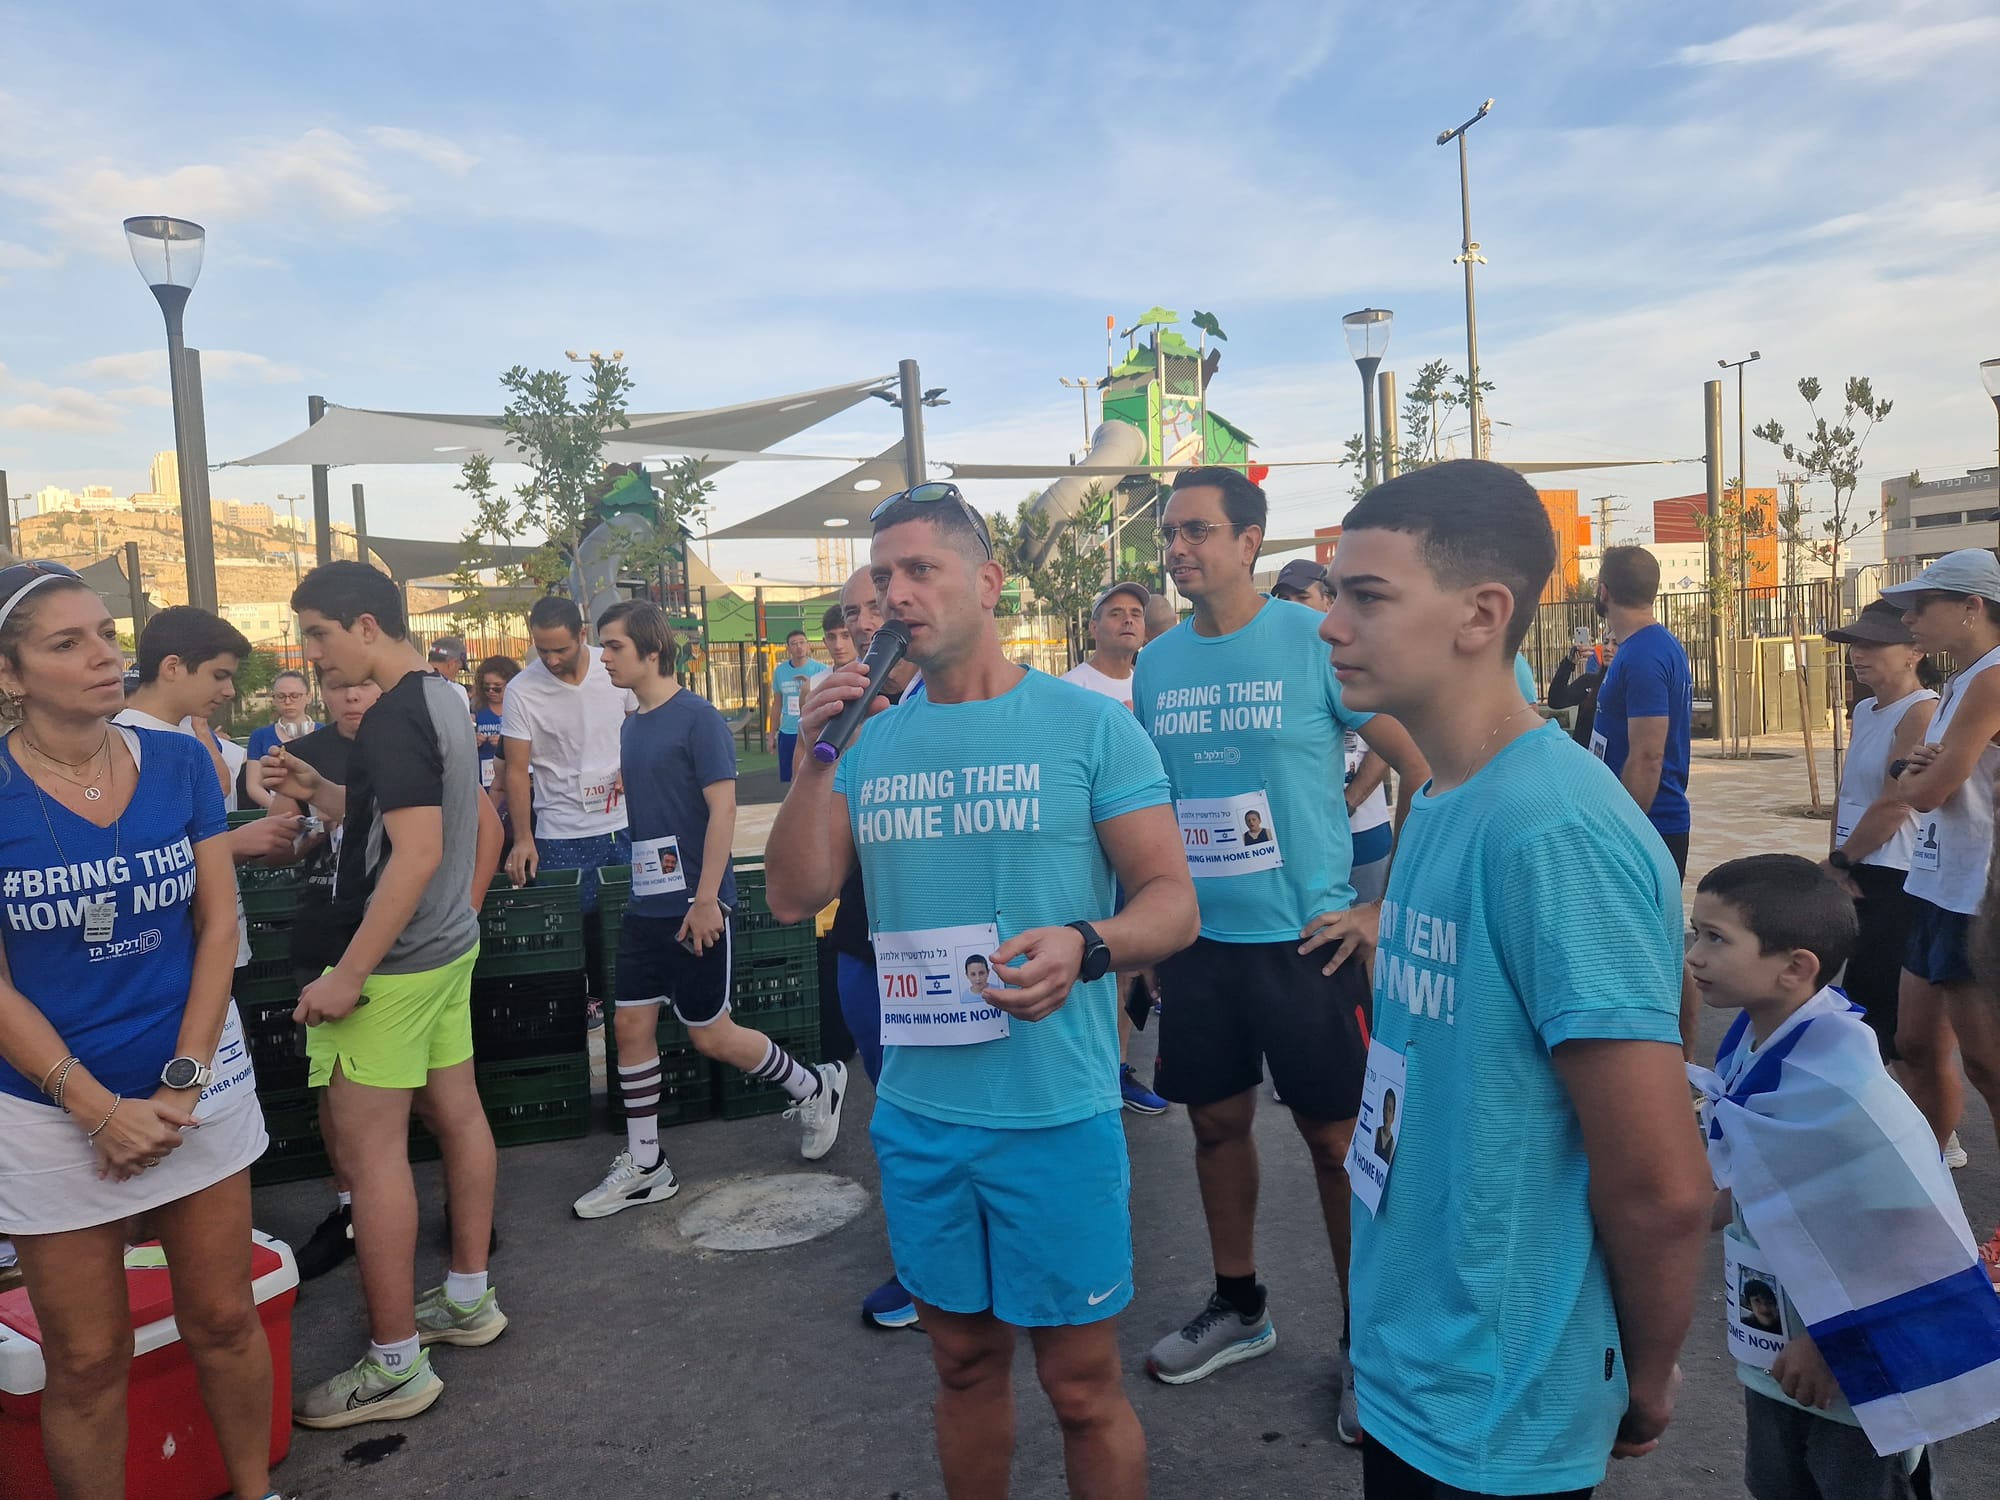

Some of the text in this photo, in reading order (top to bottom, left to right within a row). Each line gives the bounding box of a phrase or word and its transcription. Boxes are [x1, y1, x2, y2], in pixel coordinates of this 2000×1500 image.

[1157, 680, 1283, 710] #BRING THEM
[1154, 706, 1282, 736] HOME NOW!
[584, 785, 605, 797] 7.10
[860, 764, 1040, 806] #BRING THEM
[858, 798, 1040, 844] HOME NOW!
[1184, 828, 1209, 845] 7.10
[1206, 855, 1221, 863] HIM
[1223, 851, 1250, 862] HOME
[1252, 846, 1275, 857] NOW
[3, 856, 131, 898] #BRING
[6, 891, 118, 931] HOME
[89, 947, 103, 957] גז
[106, 939, 139, 954] דלקל
[937, 948, 947, 958] גל
[883, 974, 918, 998] 7.10
[885, 1007, 1002, 1024] BRING HIM HOME NOW
[210, 1079, 231, 1096] HER
[1357, 1153, 1375, 1180] HOME
[1748, 1335, 1785, 1352] NOW
